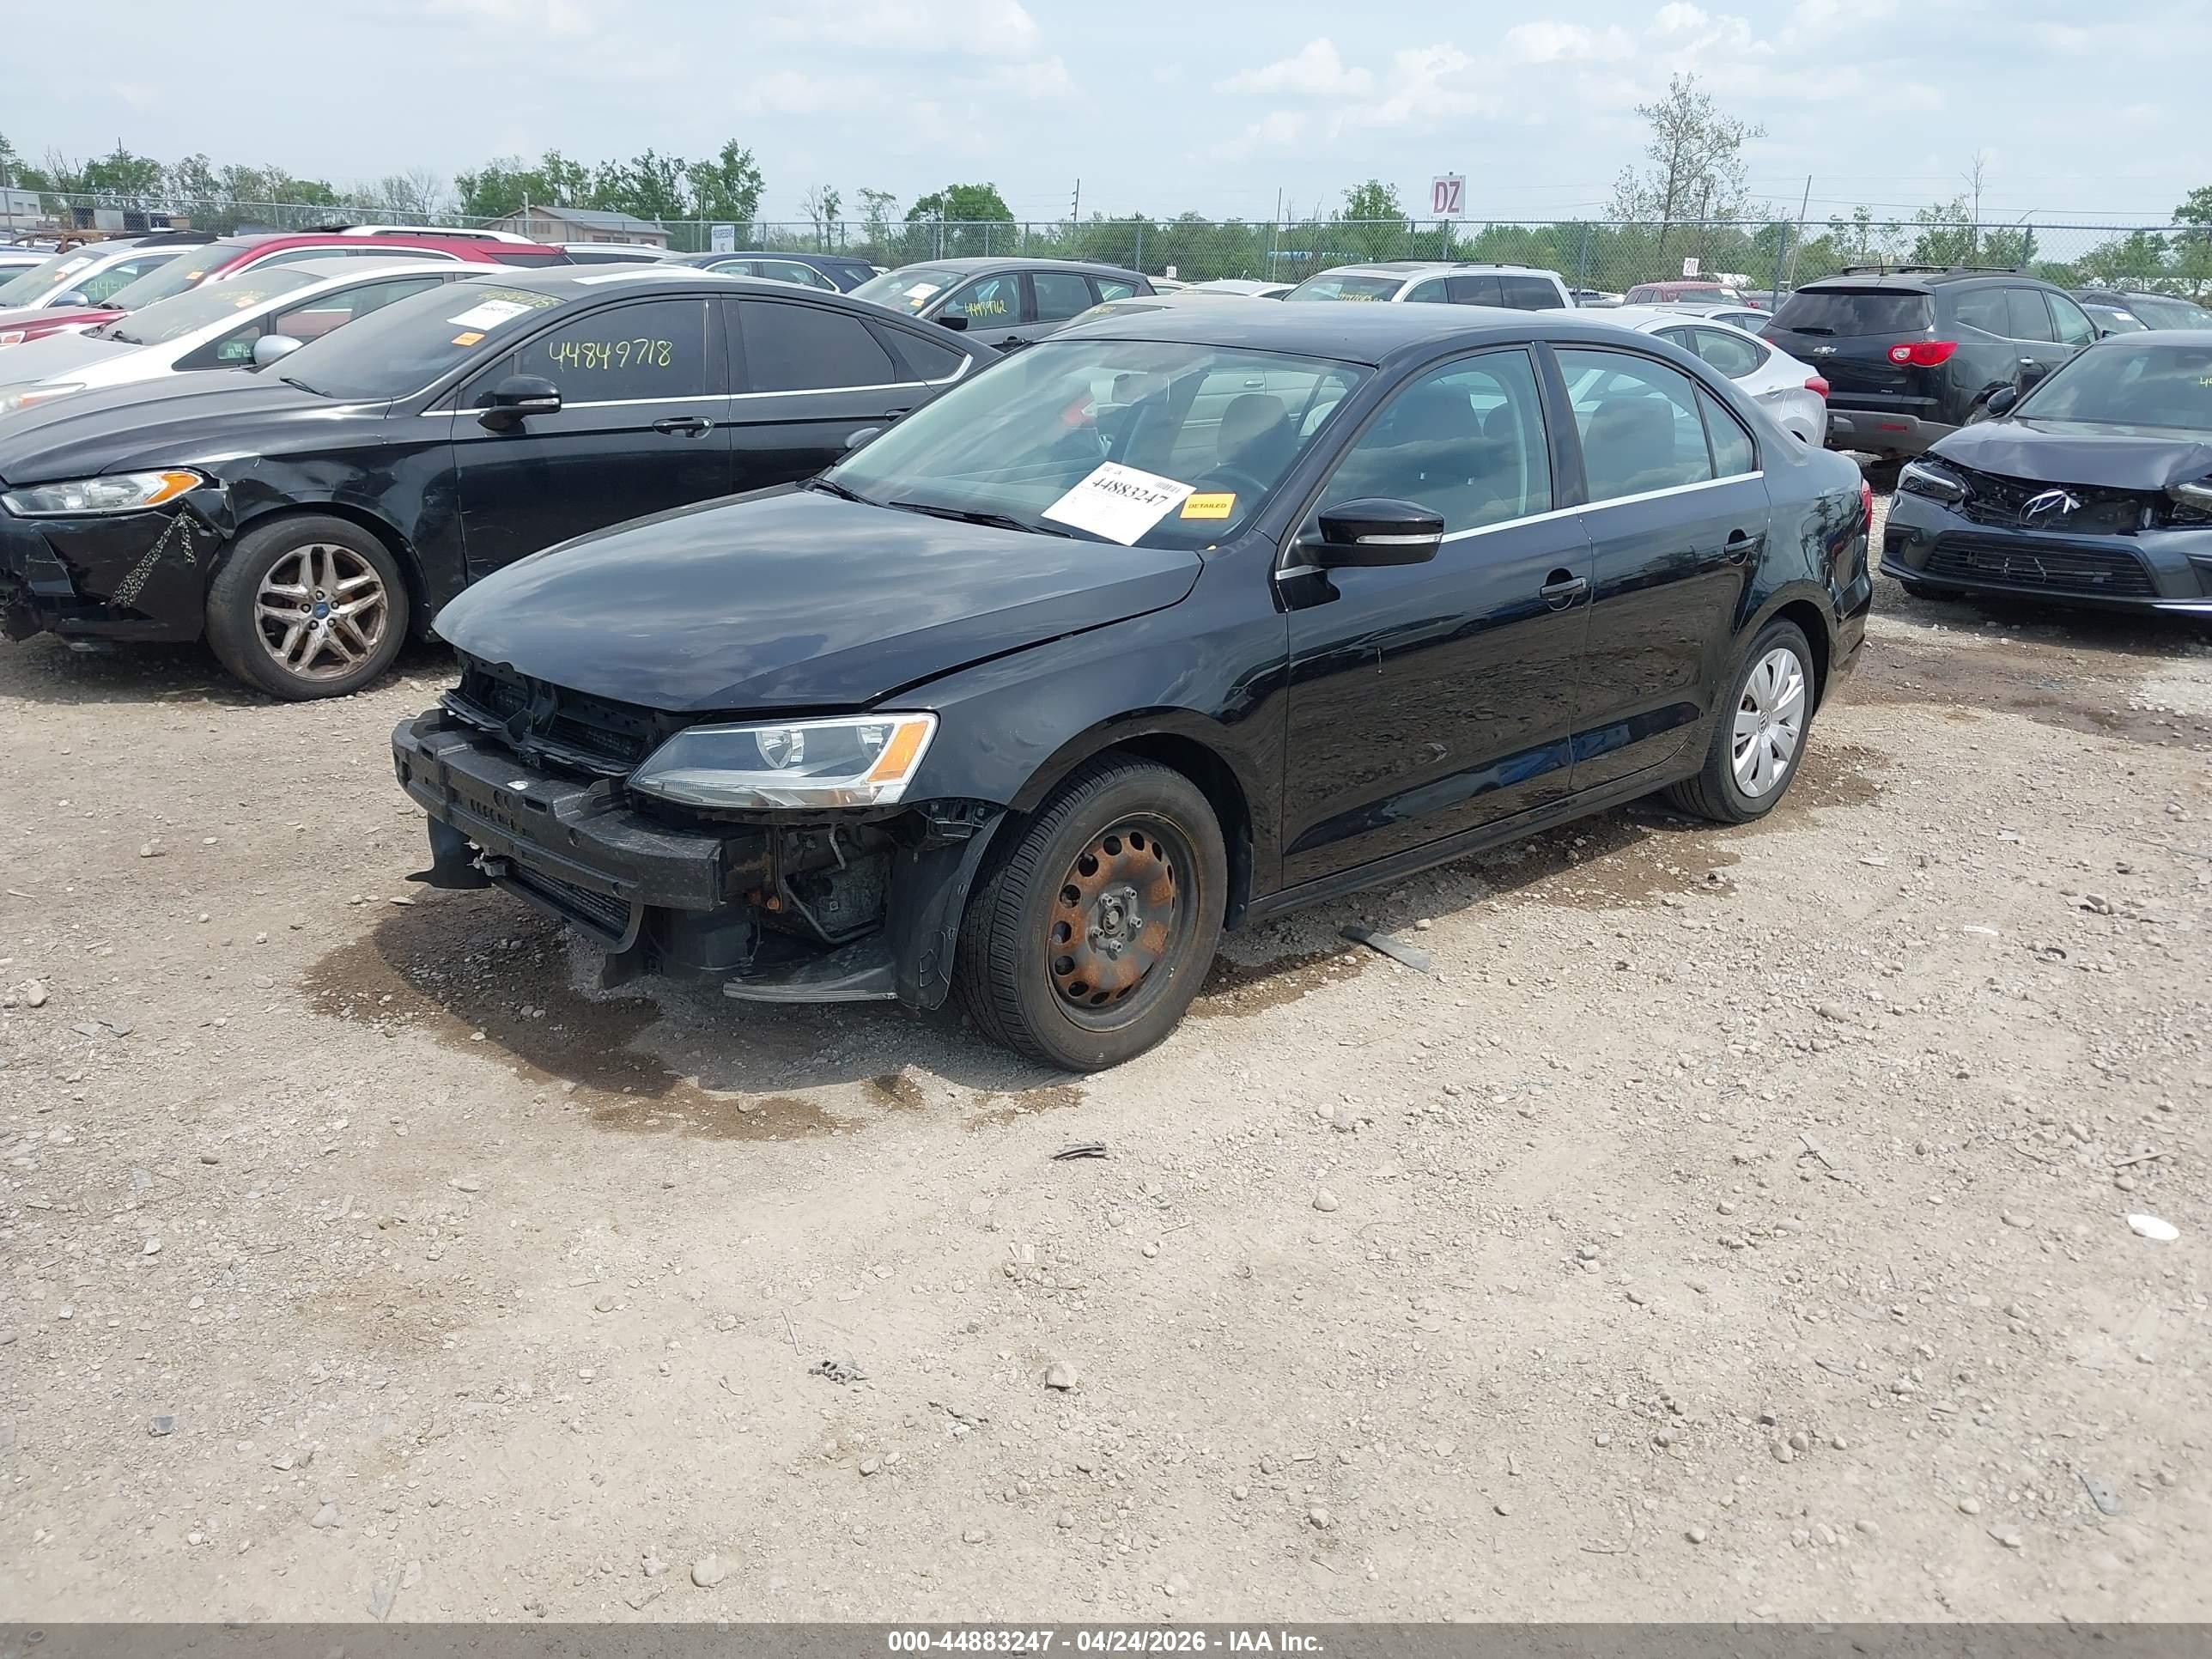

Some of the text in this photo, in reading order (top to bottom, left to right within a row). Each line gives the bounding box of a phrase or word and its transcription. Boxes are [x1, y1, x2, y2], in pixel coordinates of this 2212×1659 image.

[1433, 181, 1461, 214] DZ
[1686, 259, 1697, 275] 20
[549, 338, 673, 371] 44849718
[1091, 477, 1170, 507] 44883247
